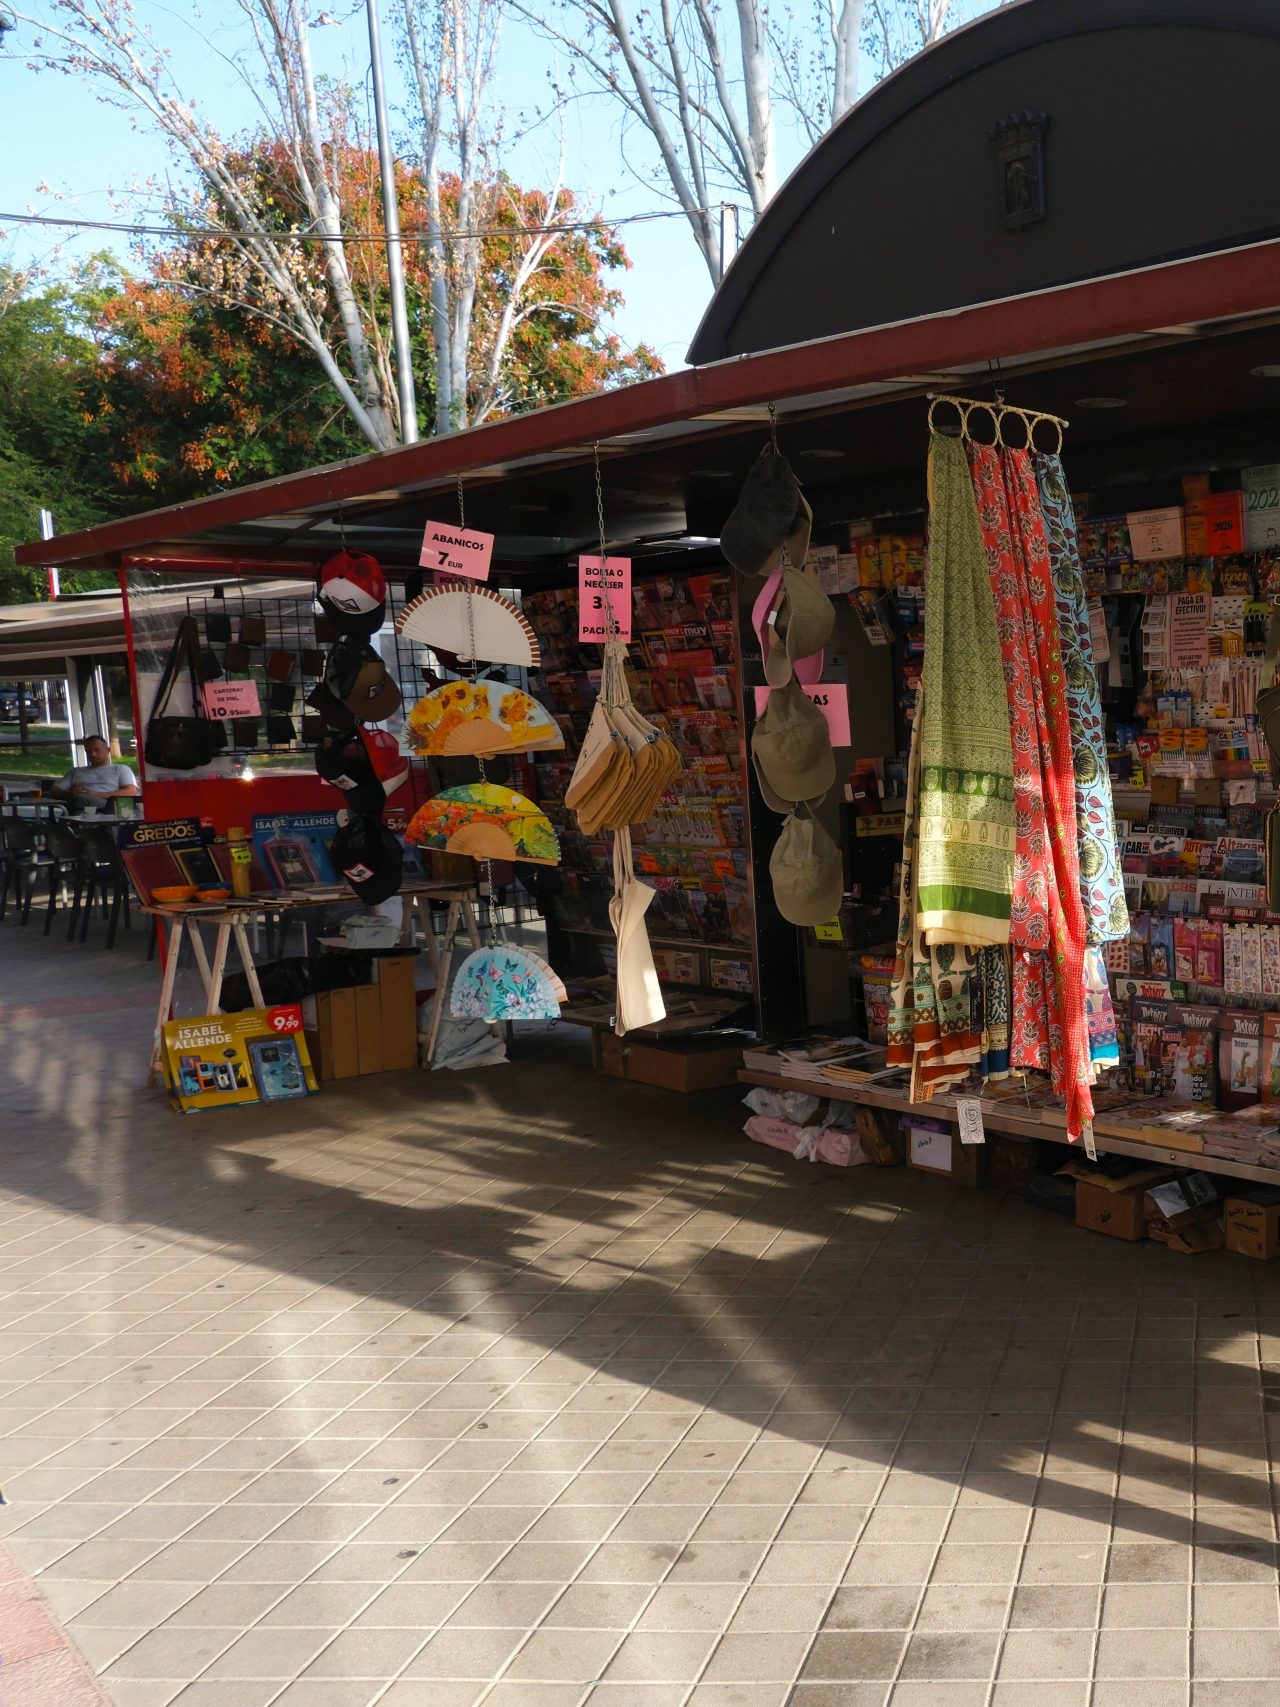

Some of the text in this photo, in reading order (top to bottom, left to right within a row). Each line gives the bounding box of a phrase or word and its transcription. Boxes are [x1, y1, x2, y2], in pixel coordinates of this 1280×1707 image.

[432, 533, 484, 550] ABANICOS
[438, 551, 463, 569] 7 EUR
[593, 596, 602, 609] 3
[1178, 595, 1203, 605] PAGA EN
[1176, 604, 1206, 615] EFECTIVO!
[293, 817, 335, 828] ALLENDE
[133, 825, 197, 842] GREDOS
[1126, 841, 1142, 853] CAR
[274, 1017, 299, 1031] 9,99
[179, 1025, 224, 1039] ISABEL
[174, 1034, 232, 1050] ALLENDE
